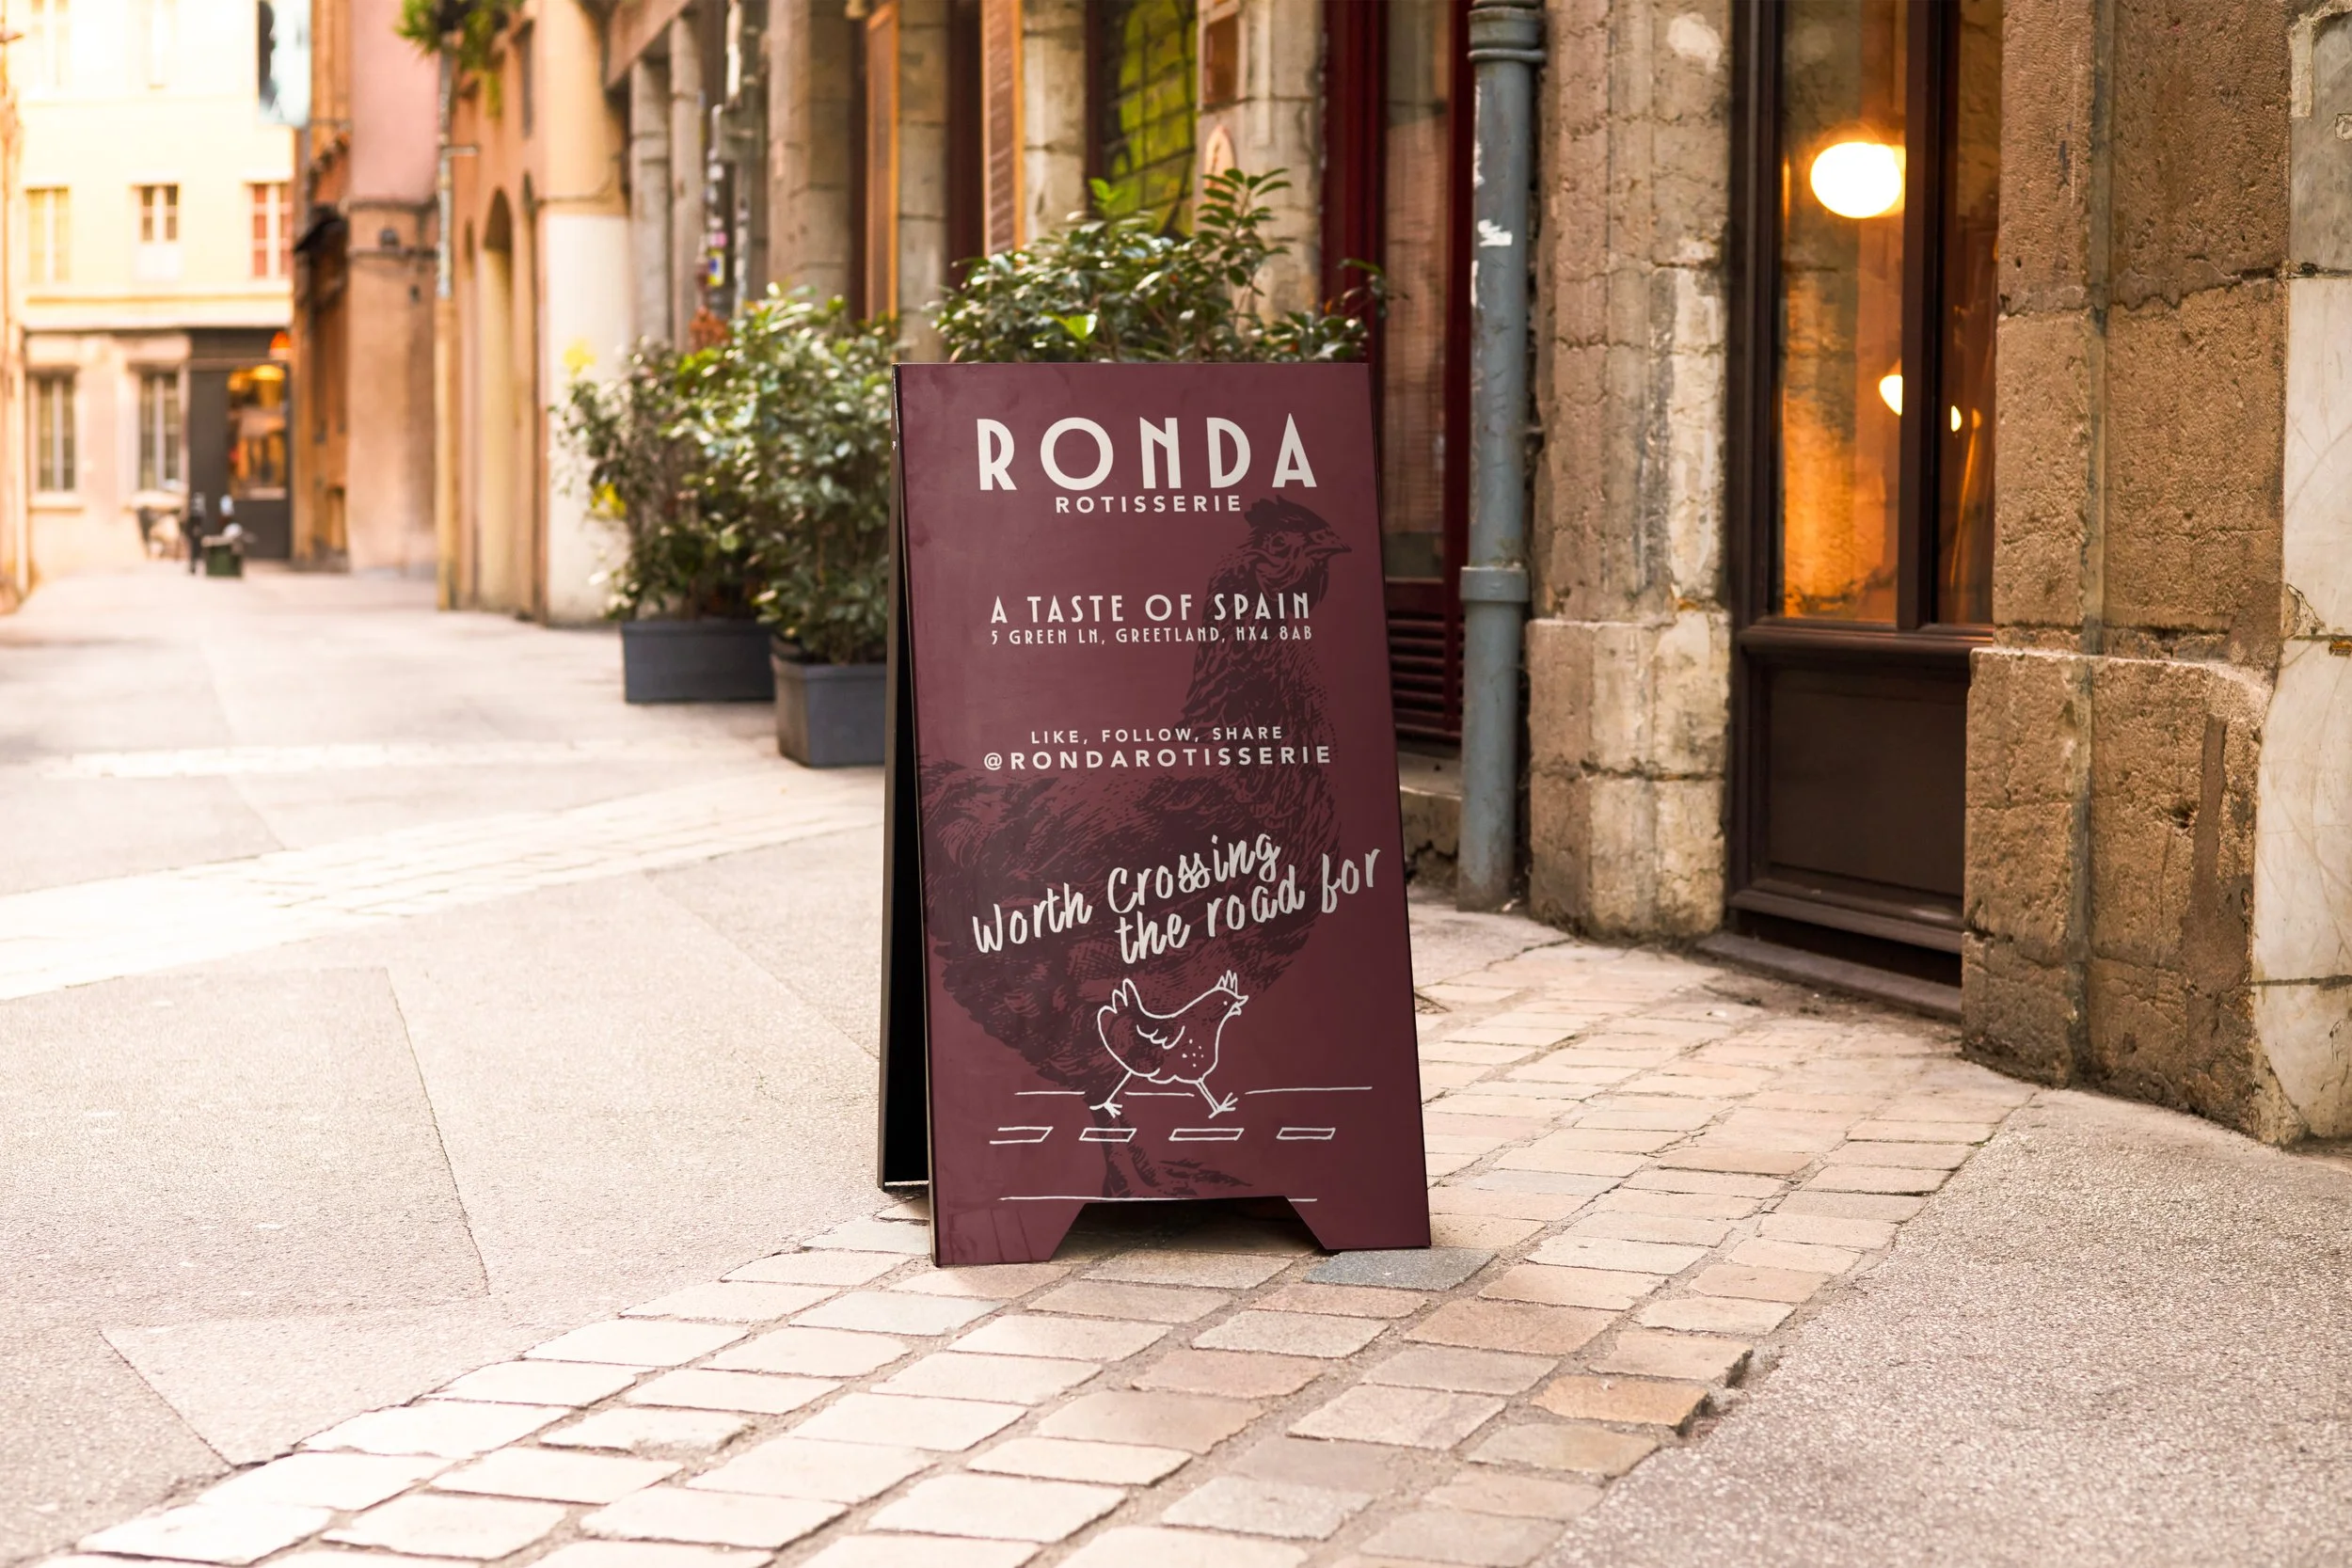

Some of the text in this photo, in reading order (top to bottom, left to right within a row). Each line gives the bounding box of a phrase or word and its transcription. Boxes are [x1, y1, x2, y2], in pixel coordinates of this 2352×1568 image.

[977, 413, 1317, 491] RONDA
[1056, 495, 1241, 514] ROTISSERIE
[991, 593, 1310, 625] A TASTE OF SPAIN
[991, 626, 1312, 646] 5 GREEN LN, GREETLAND, HX4 8AB
[1031, 726, 1283, 745] LIKE, FOLLOW, SHARE
[983, 746, 1331, 771] @RONDAROTISSERIE
[972, 833, 1281, 954] Worth Crossing
[1114, 848, 1381, 964] the road for
